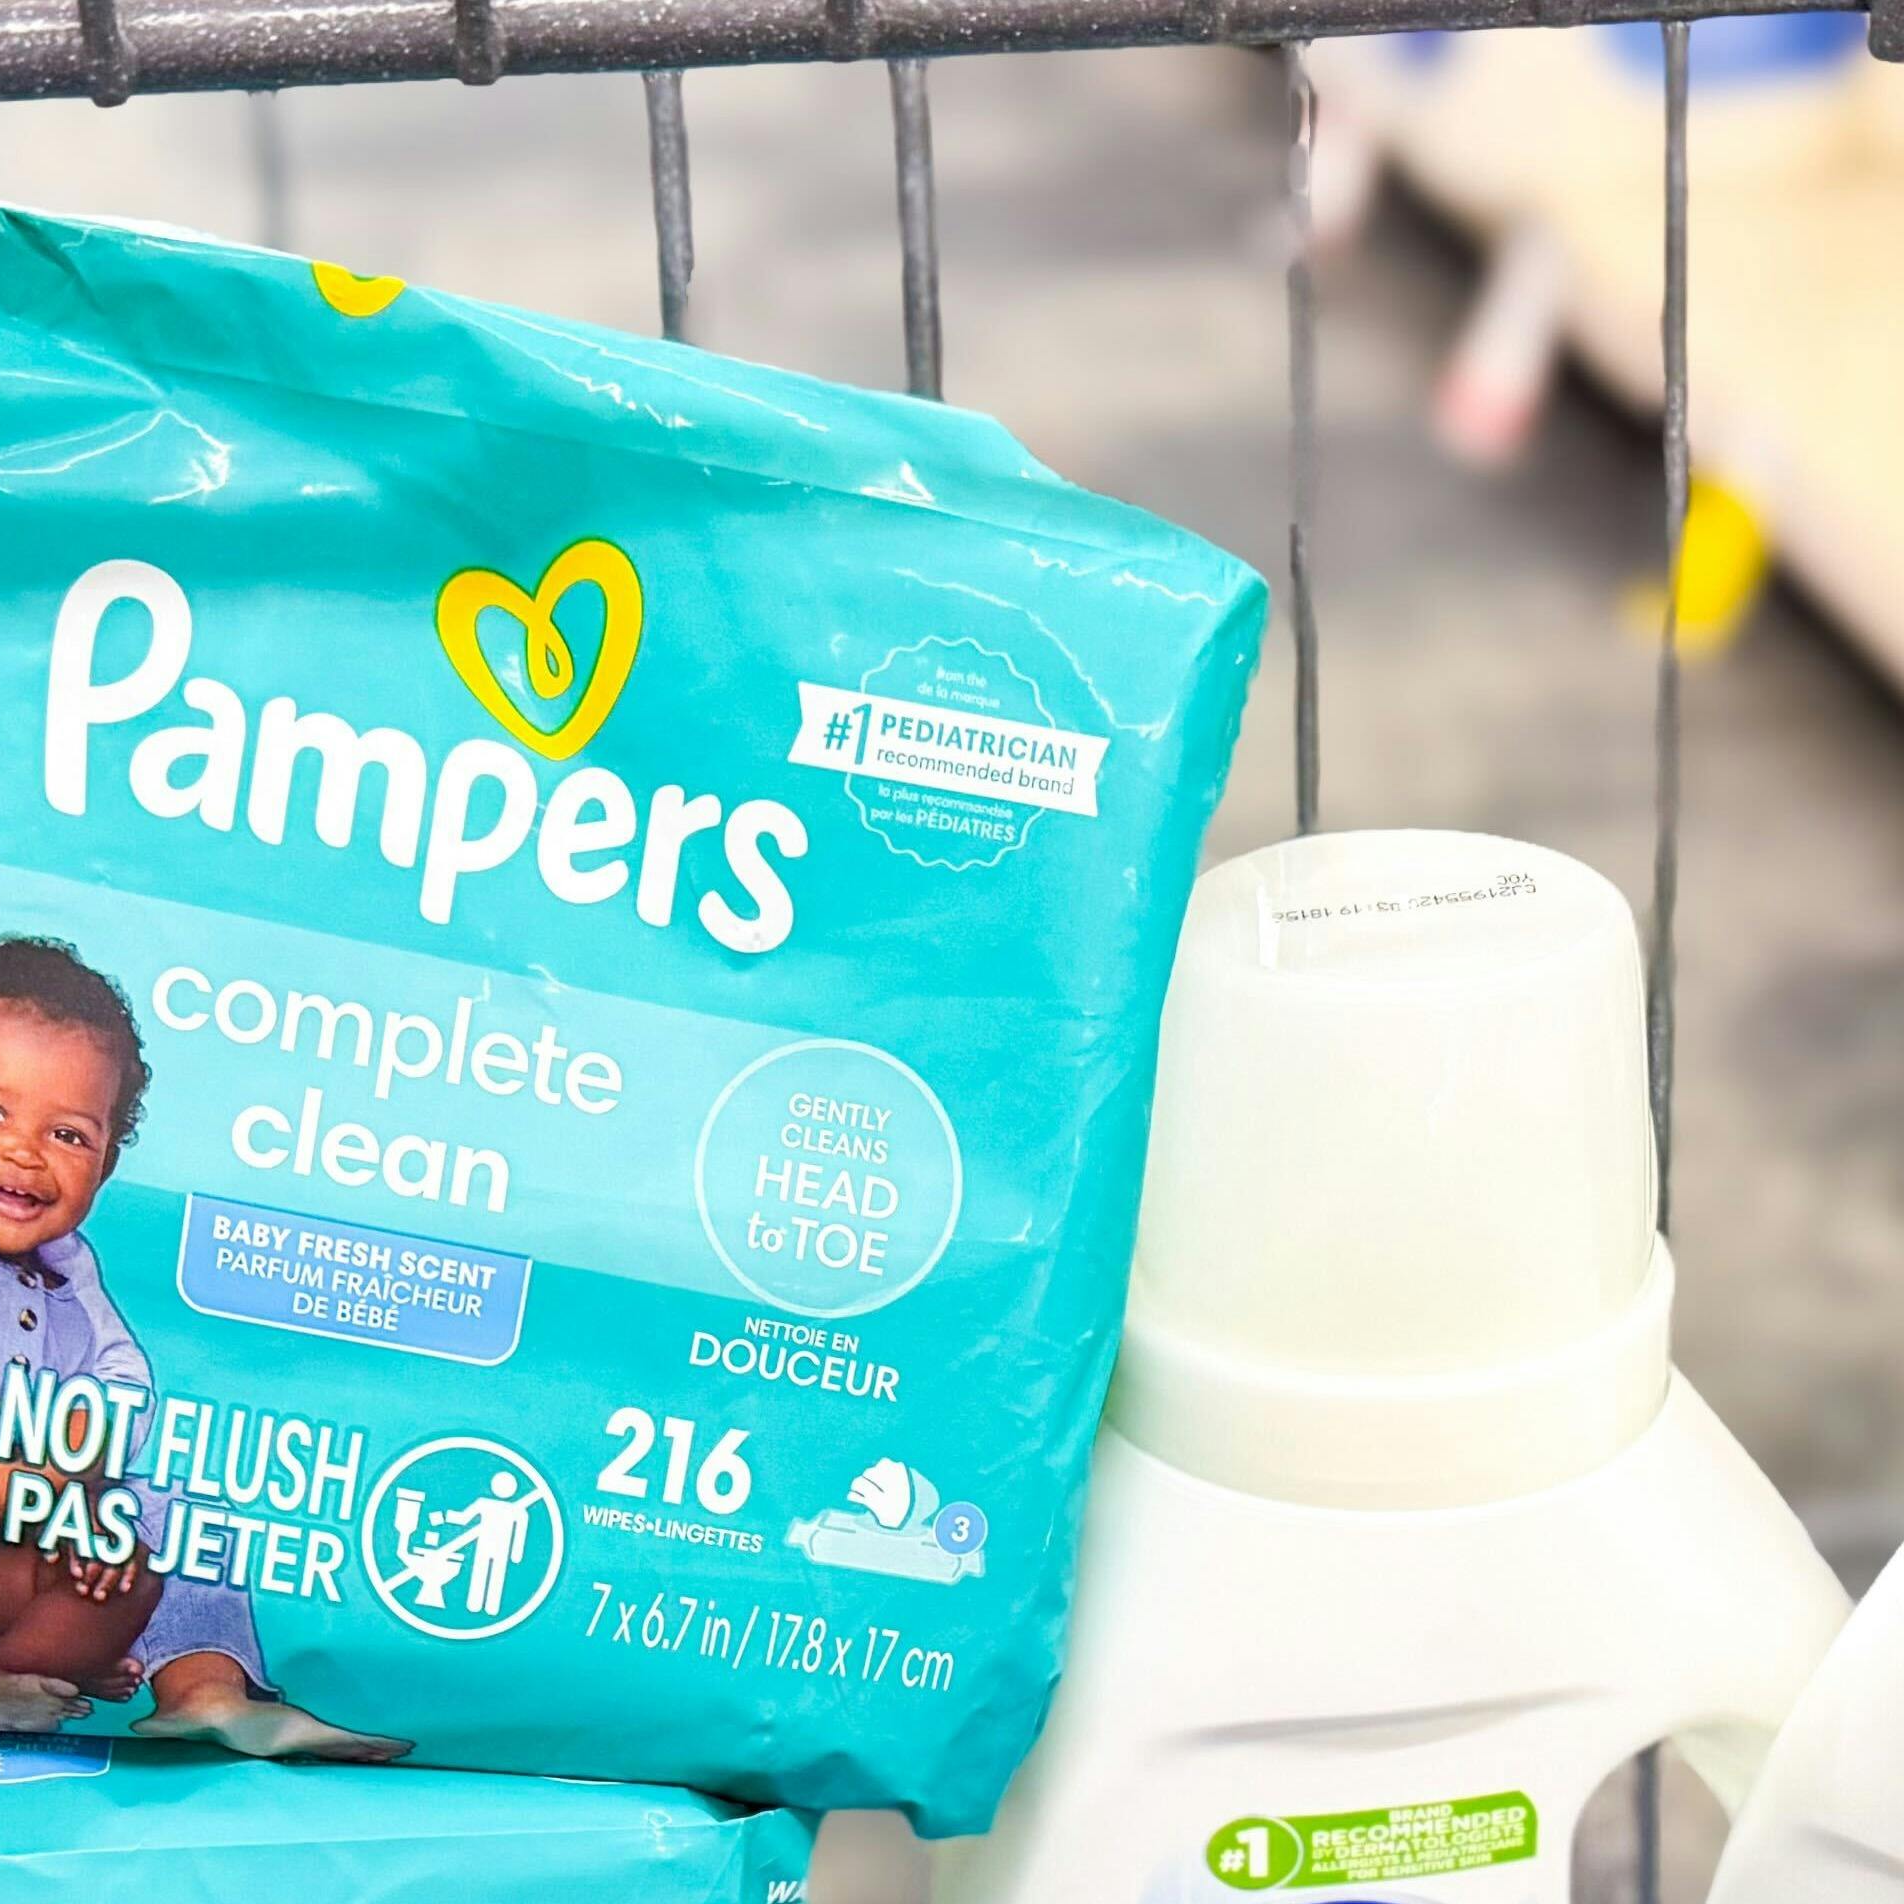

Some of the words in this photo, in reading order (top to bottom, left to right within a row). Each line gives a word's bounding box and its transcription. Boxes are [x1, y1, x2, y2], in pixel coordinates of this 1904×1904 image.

[43, 558, 808, 953] Pampers
[824, 703, 872, 765] #1
[880, 713, 1077, 769] PEDIATRICIAN
[876, 748, 1014, 784] recommended
[1018, 769, 1074, 795] brand
[152, 966, 623, 1115] complete
[781, 1122, 889, 1164] CLEANS
[788, 1092, 892, 1134] GENTLY
[232, 1087, 511, 1212] clean
[754, 1156, 898, 1221] HEAD
[213, 1216, 291, 1252] BABY
[297, 1230, 390, 1272] FRESH
[399, 1249, 496, 1290] SCENT
[746, 1216, 784, 1256] to
[792, 1222, 889, 1276] TOE
[216, 1248, 324, 1289] PARFUM
[332, 1264, 482, 1318] FRAÎCHEUR
[292, 1294, 328, 1320] DE
[334, 1294, 400, 1332] BÉBÉ
[689, 1331, 900, 1402] DOUCEUR
[160, 1396, 363, 1520] FLUSH
[598, 1407, 754, 1516] 216
[2, 1471, 141, 1567] PAS
[148, 1512, 345, 1602] JETER
[951, 1512, 971, 1545] 3
[586, 1582, 612, 1637] 7
[612, 1602, 637, 1644] x
[642, 1593, 698, 1650] 6.7
[700, 1601, 731, 1658] in
[733, 1605, 760, 1669] /
[766, 1611, 827, 1673] 17.8
[829, 1637, 852, 1678] x
[862, 1627, 900, 1682] 17
[902, 1646, 954, 1692] cm
